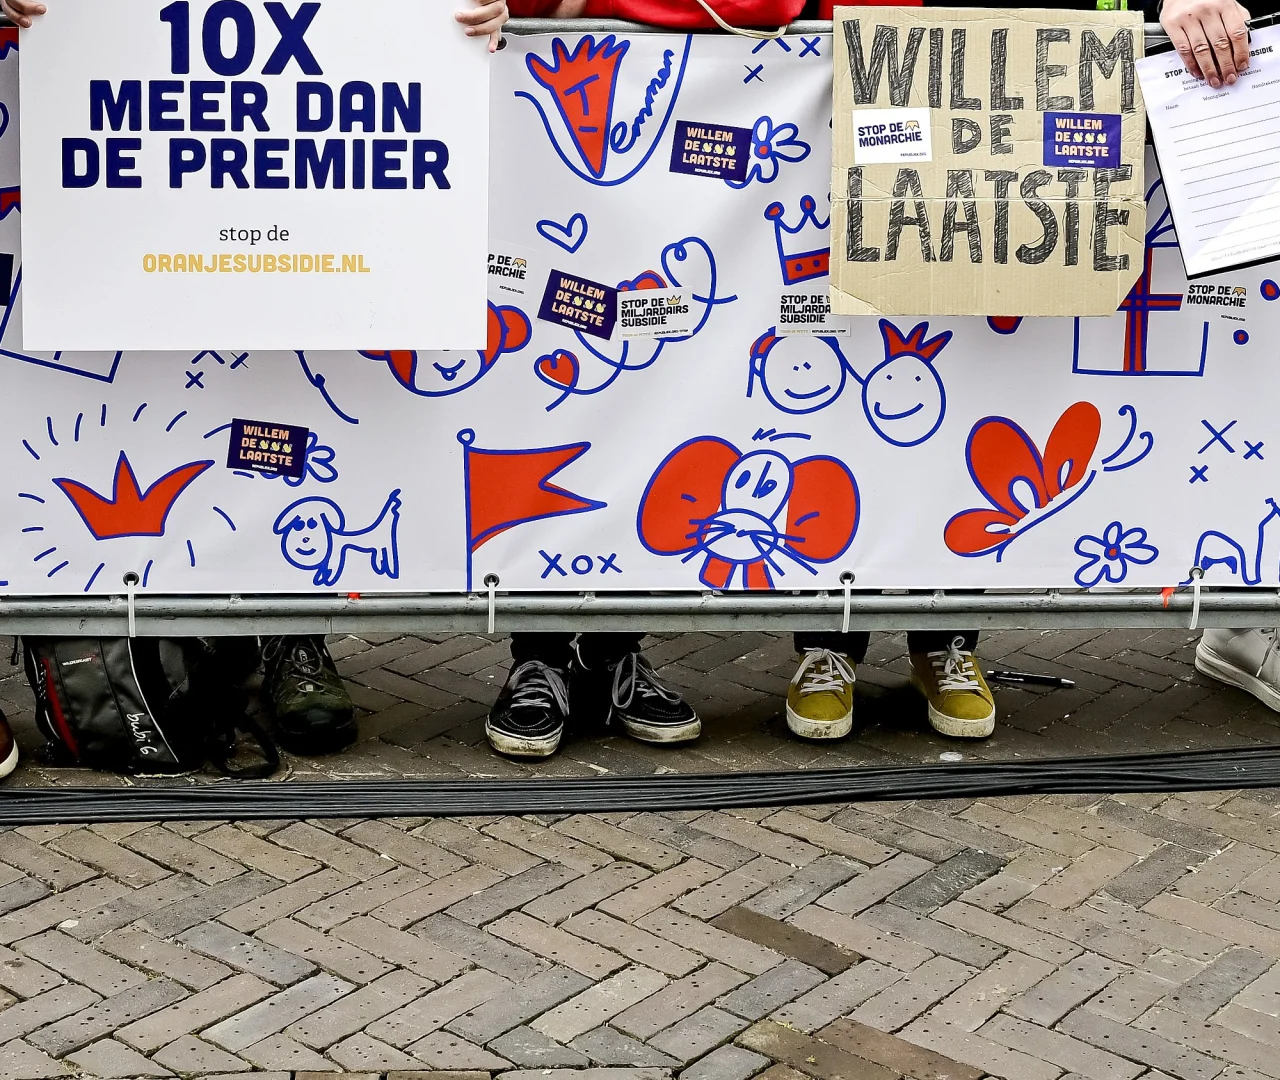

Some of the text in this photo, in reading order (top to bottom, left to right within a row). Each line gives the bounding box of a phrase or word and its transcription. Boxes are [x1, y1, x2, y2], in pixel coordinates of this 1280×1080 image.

[158, 0, 324, 76] 10X
[841, 18, 1137, 113] WILLEM
[88, 79, 422, 133] MEER DAN
[857, 121, 904, 136] STOP DE
[1055, 117, 1102, 130] WILLEM
[686, 126, 733, 143] WILLEM
[858, 131, 923, 148] MONARCHIE
[950, 114, 1015, 156] DE
[1055, 131, 1071, 142] DE
[684, 139, 701, 152] DE
[1054, 145, 1109, 157] LAATSTE
[61, 137, 452, 191] DE PREMIER
[682, 152, 737, 170] LAATSTE
[845, 165, 1134, 271] LAATSTE
[218, 224, 291, 245] stop de
[142, 253, 371, 275] ORANJESUBSIDIE.NL
[497, 255, 512, 267] DE
[488, 265, 527, 280] ARCHIE
[555, 289, 571, 303] DE
[559, 277, 605, 300] WILLEM
[1188, 284, 1232, 295] STOP DE
[621, 297, 665, 310] STOP DE
[781, 295, 824, 304] STOP DE
[1186, 294, 1247, 307] MONARCHIE
[551, 301, 605, 327] LAATSTE
[621, 304, 689, 318] MILJARDAIRS
[780, 314, 826, 323] SUBSIDIE
[621, 316, 667, 328] SUBSIDIE
[243, 425, 290, 440] WILLEM
[241, 437, 258, 448] DE
[239, 449, 294, 466] LAATSTE
